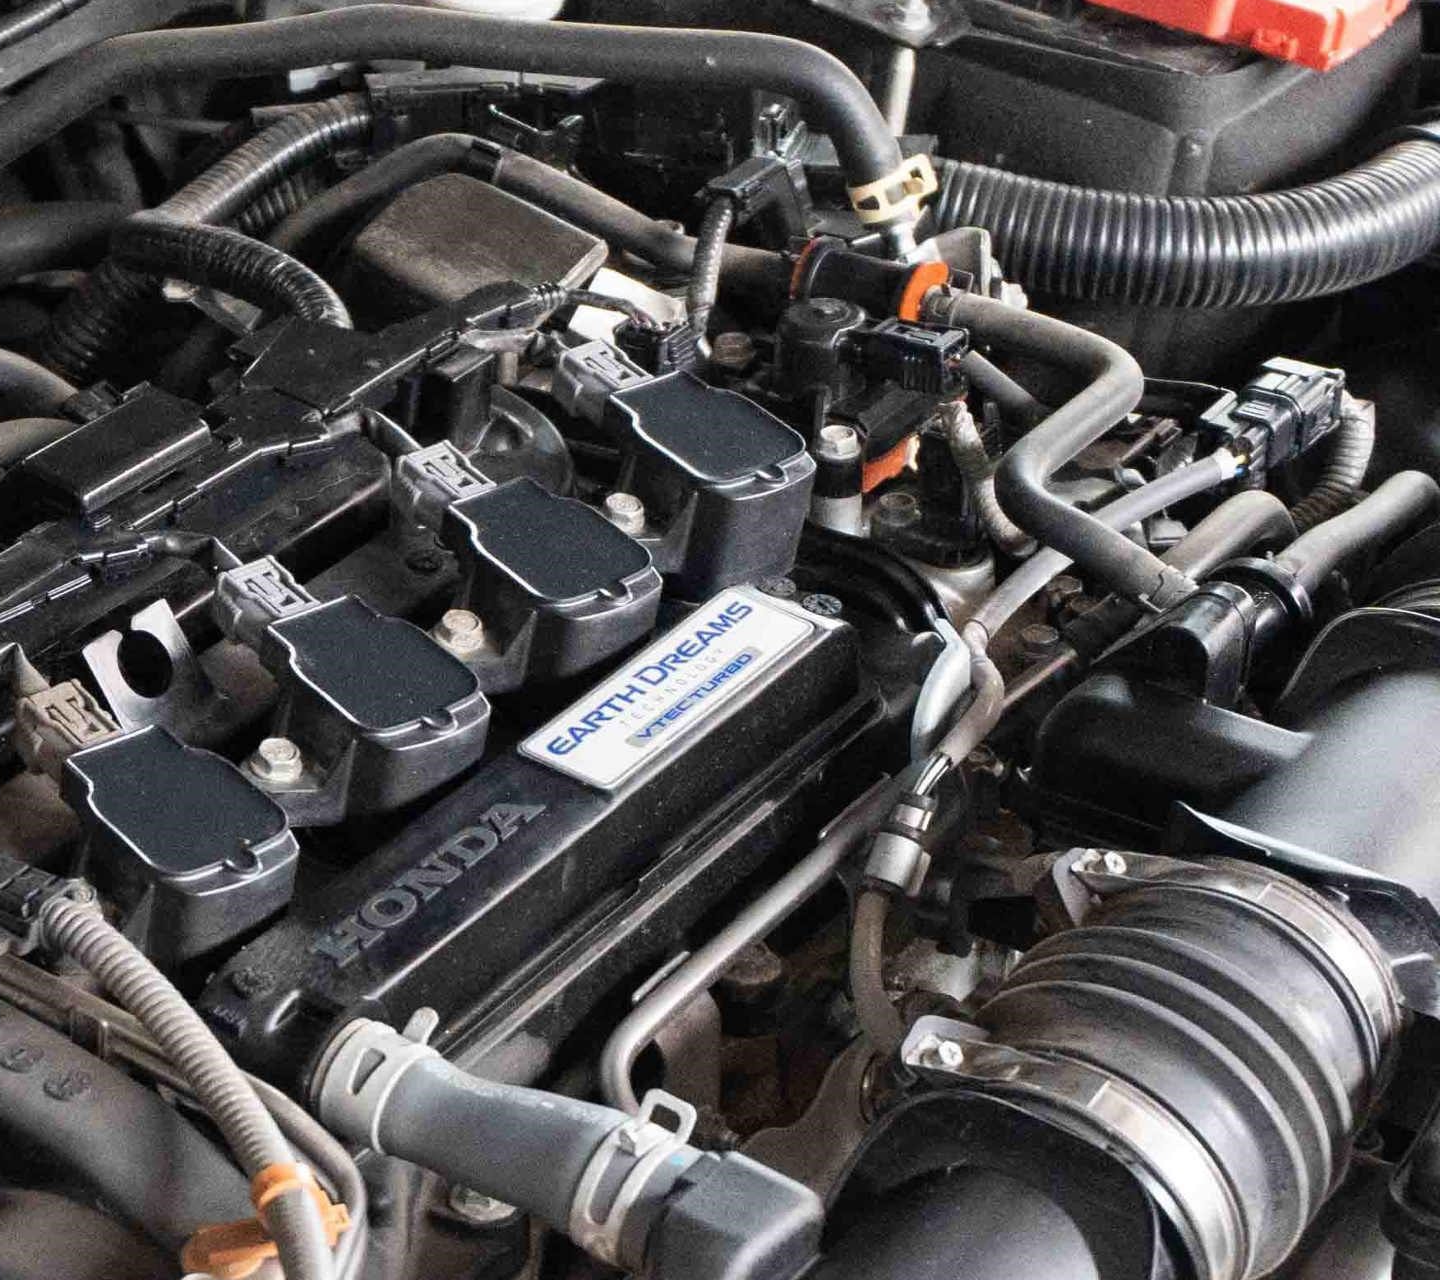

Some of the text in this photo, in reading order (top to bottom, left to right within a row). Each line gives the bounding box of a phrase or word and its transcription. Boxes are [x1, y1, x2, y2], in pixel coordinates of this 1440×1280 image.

[546, 600, 754, 756] EARTH DREAMS
[312, 803, 550, 967] HONDA
